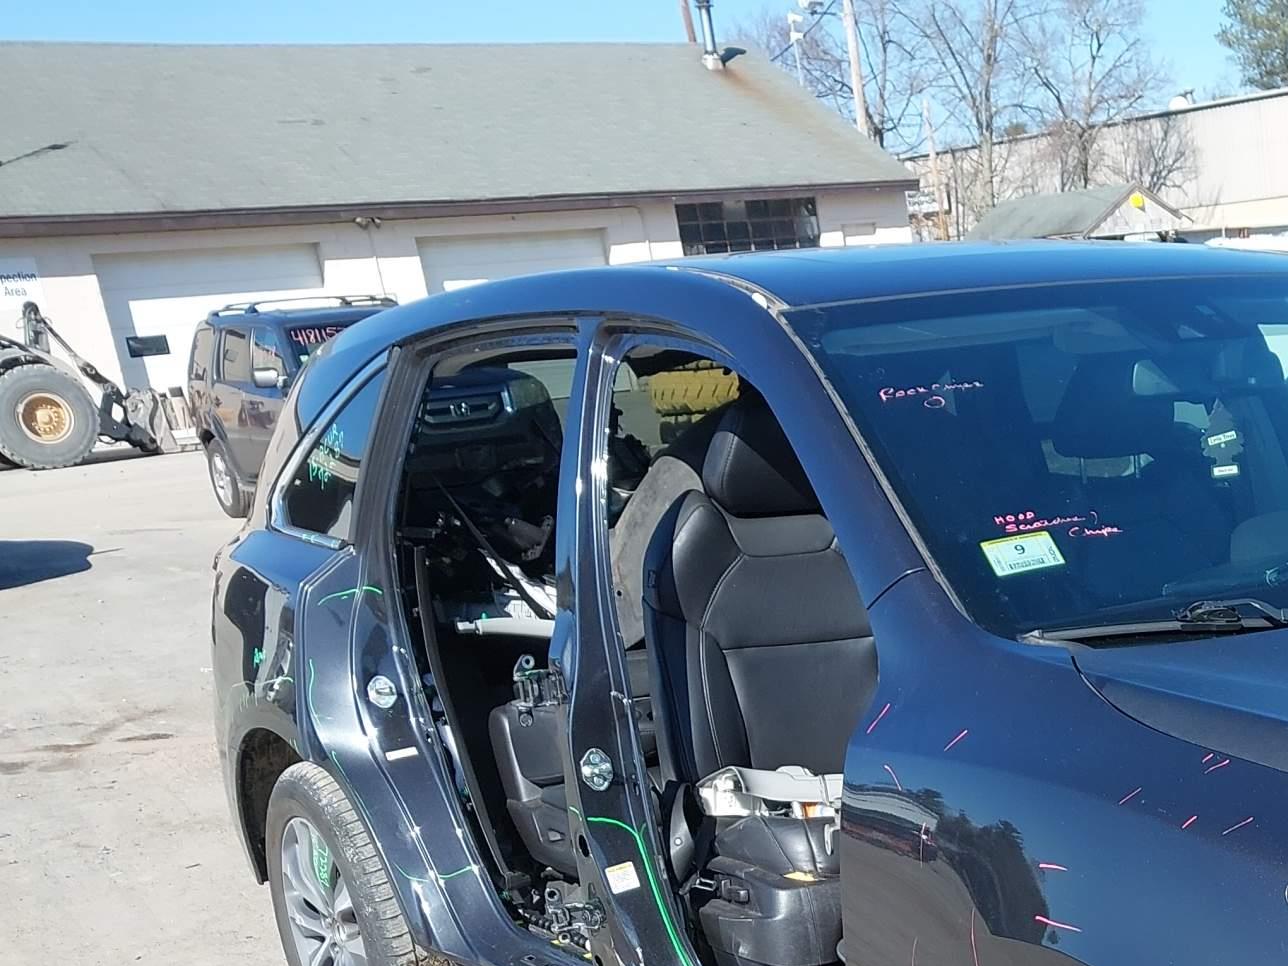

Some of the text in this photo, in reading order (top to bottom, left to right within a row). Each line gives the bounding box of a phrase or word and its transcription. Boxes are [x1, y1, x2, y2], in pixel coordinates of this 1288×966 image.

[5, 286, 27, 296] Area
[291, 327, 345, 346] 418115
[994, 511, 1035, 524] HOOD
[1014, 544, 1025, 555] 9
